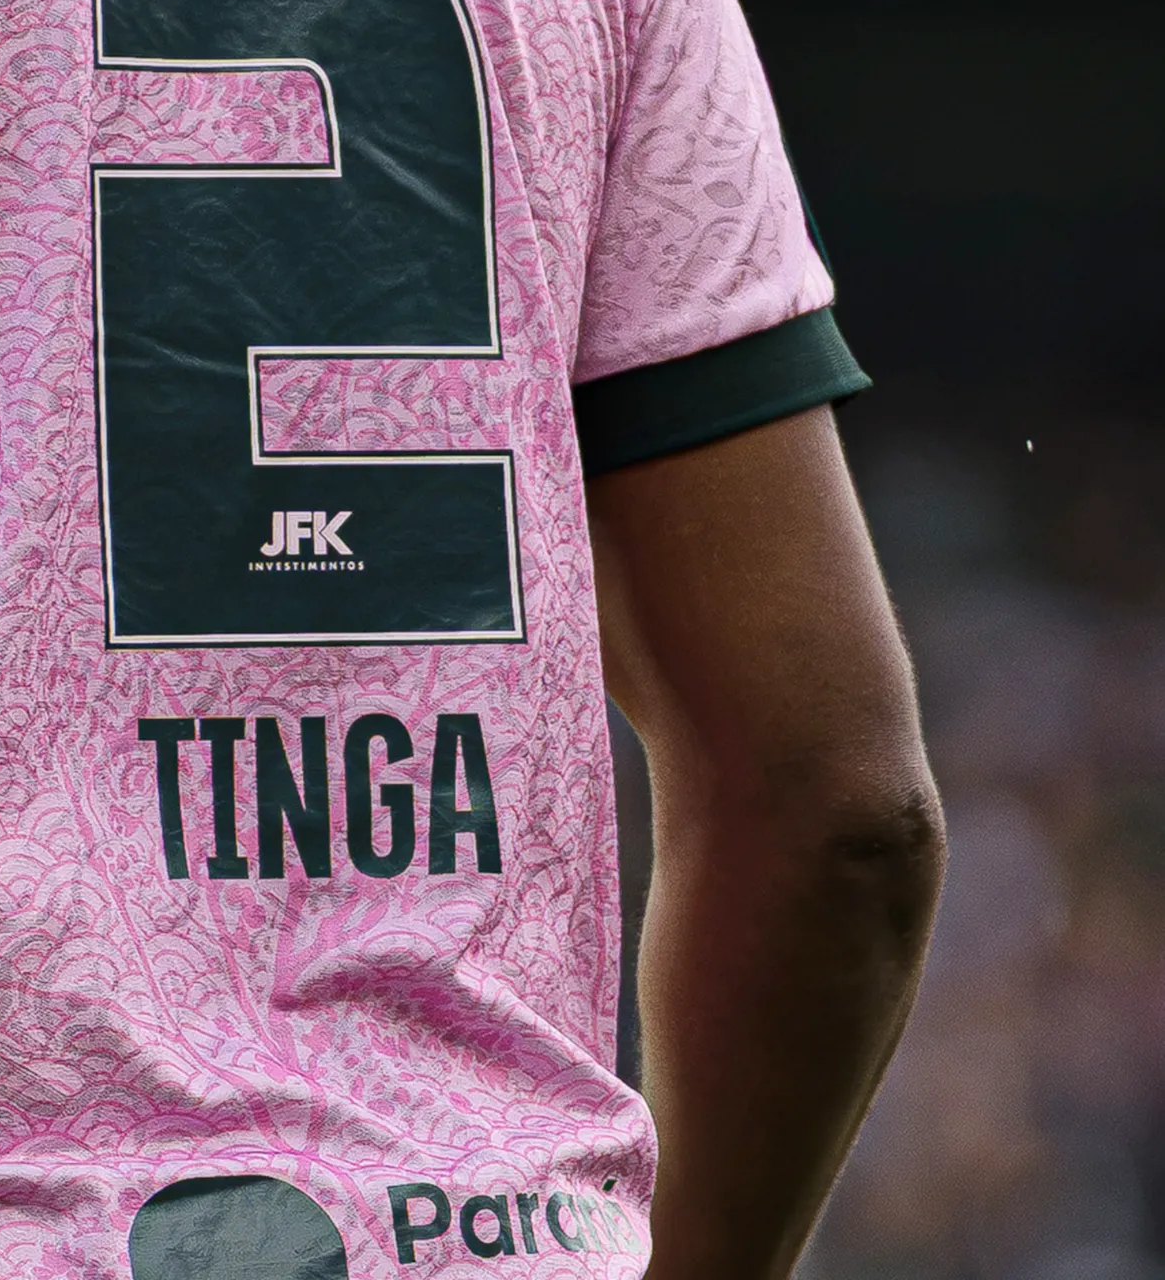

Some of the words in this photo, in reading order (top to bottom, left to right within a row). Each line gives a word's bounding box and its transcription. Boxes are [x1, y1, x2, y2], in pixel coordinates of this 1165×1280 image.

[260, 510, 354, 557] JFK
[248, 560, 365, 571] INVESTIMENTOS
[137, 713, 503, 880] TINGA
